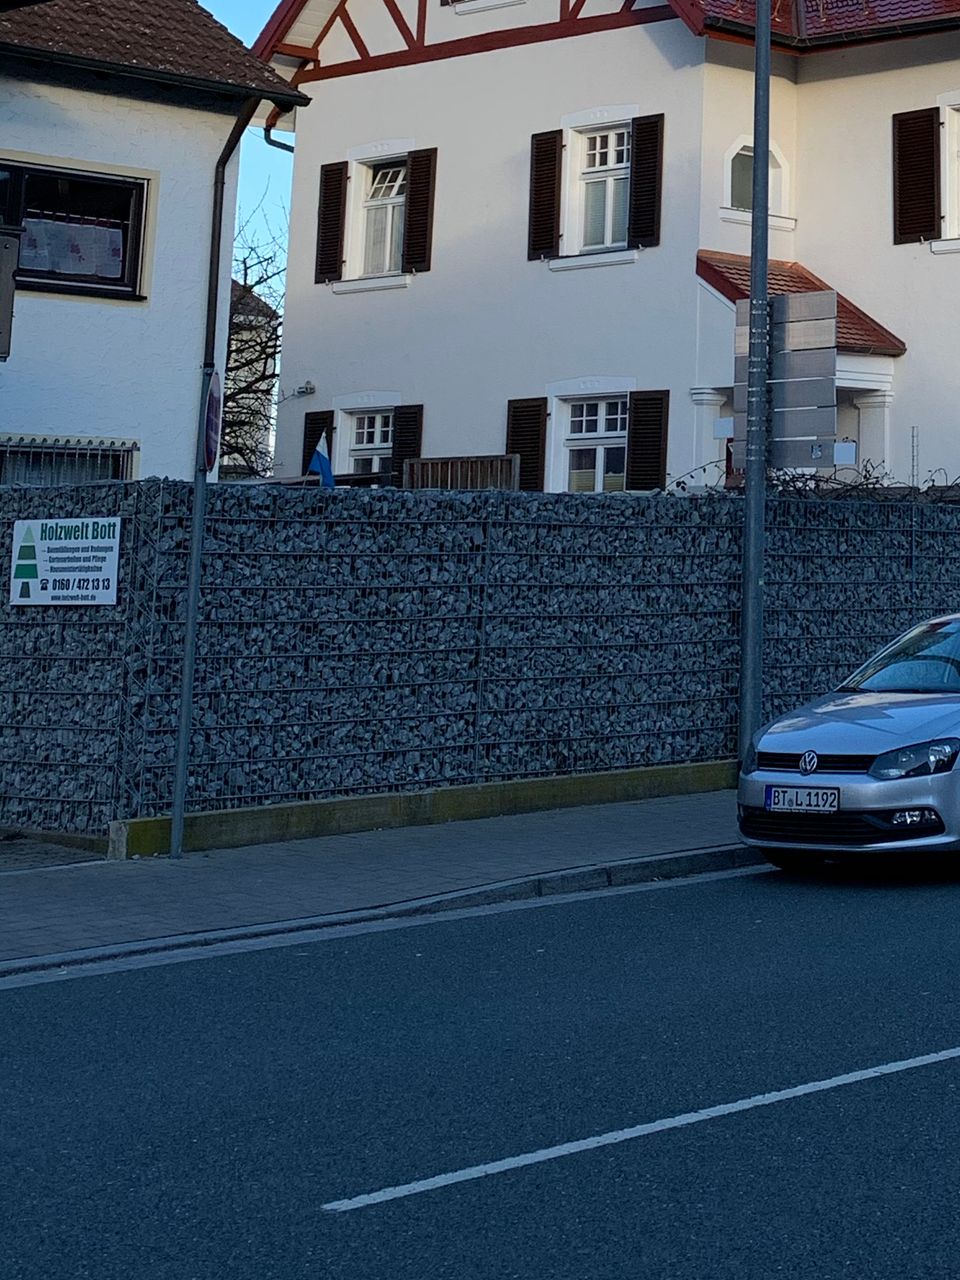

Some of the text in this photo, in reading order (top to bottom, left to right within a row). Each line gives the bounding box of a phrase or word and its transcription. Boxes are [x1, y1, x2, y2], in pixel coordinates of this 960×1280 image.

[40, 522, 116, 540] Holzwelt Bott
[52, 578, 69, 591] 0160
[76, 578, 90, 590] 472
[91, 578, 100, 590] 13
[102, 578, 111, 590] 13
[773, 790, 837, 808] BT L 1192
